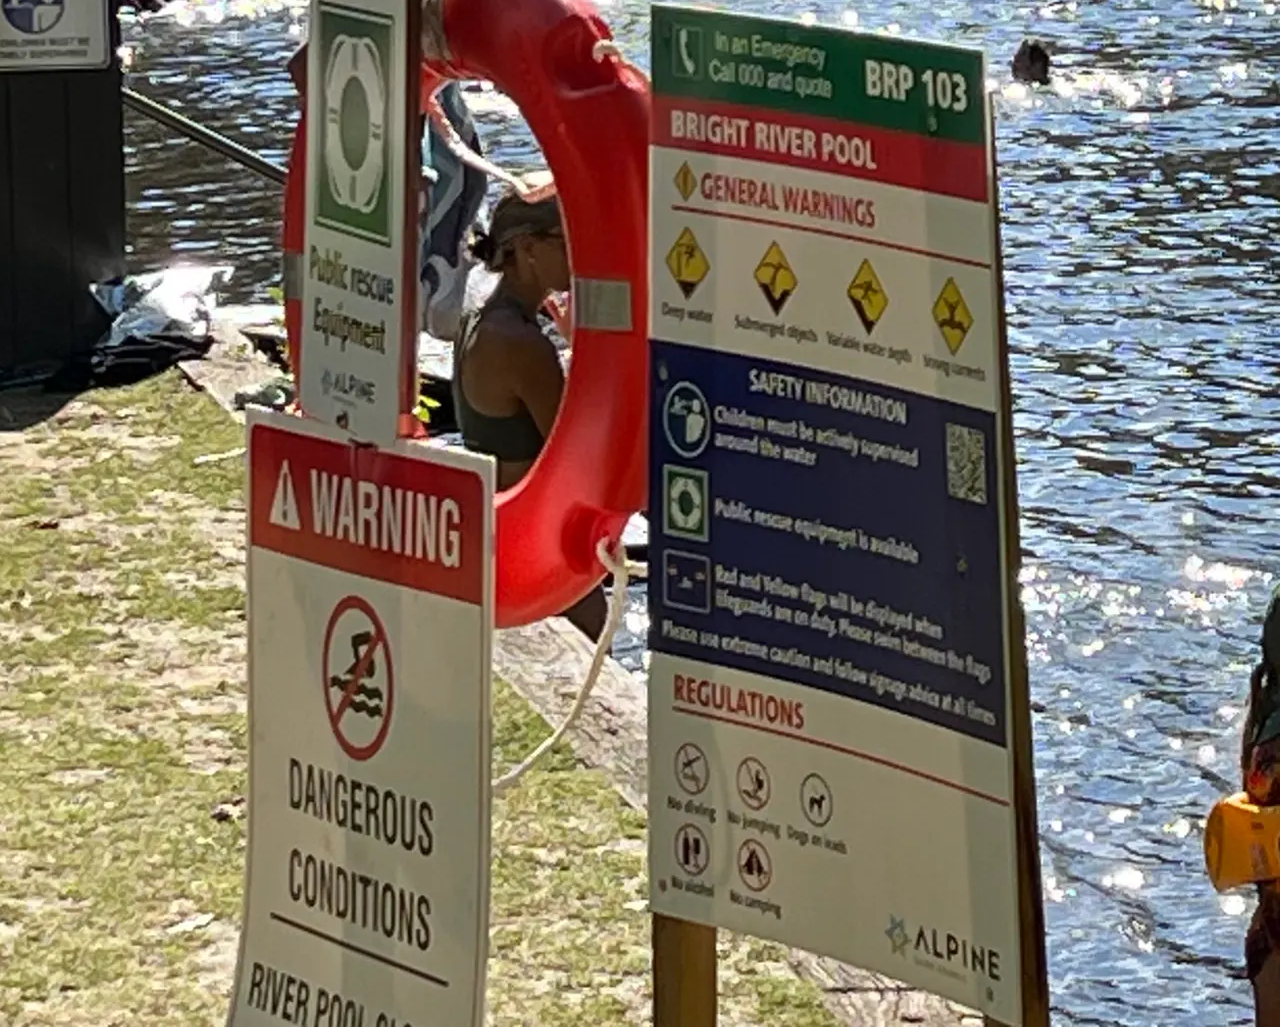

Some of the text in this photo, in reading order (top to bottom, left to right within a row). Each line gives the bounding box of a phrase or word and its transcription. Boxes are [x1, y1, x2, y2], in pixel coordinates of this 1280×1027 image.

[708, 57, 833, 99] Call 000 and quote
[715, 30, 827, 71] In an Emergency
[864, 59, 968, 112] BRP 103
[670, 109, 877, 170] BRIGHT RIVER POOL
[700, 172, 876, 229] GENERAL WARNINGS
[310, 245, 394, 305] Public rescue
[313, 297, 386, 355] Equipment
[748, 368, 907, 425] SAFETY INFORMATION
[714, 405, 919, 468] Children must be actively supervised
[715, 432, 817, 466] around the water
[309, 468, 462, 568] WARNING
[714, 497, 752, 523] Public
[753, 509, 793, 532] rescue
[794, 517, 857, 551] equipment
[870, 536, 919, 564] available
[662, 619, 698, 644] Please
[721, 636, 769, 661] extreme
[769, 647, 811, 670] caution
[838, 618, 872, 644] Please
[673, 673, 805, 730] REGULATIONS
[289, 757, 434, 857] DANGEROUS
[288, 847, 431, 951] CONDITIONS
[914, 925, 1002, 982] ALPINE
[246, 961, 310, 1027] RIVER
